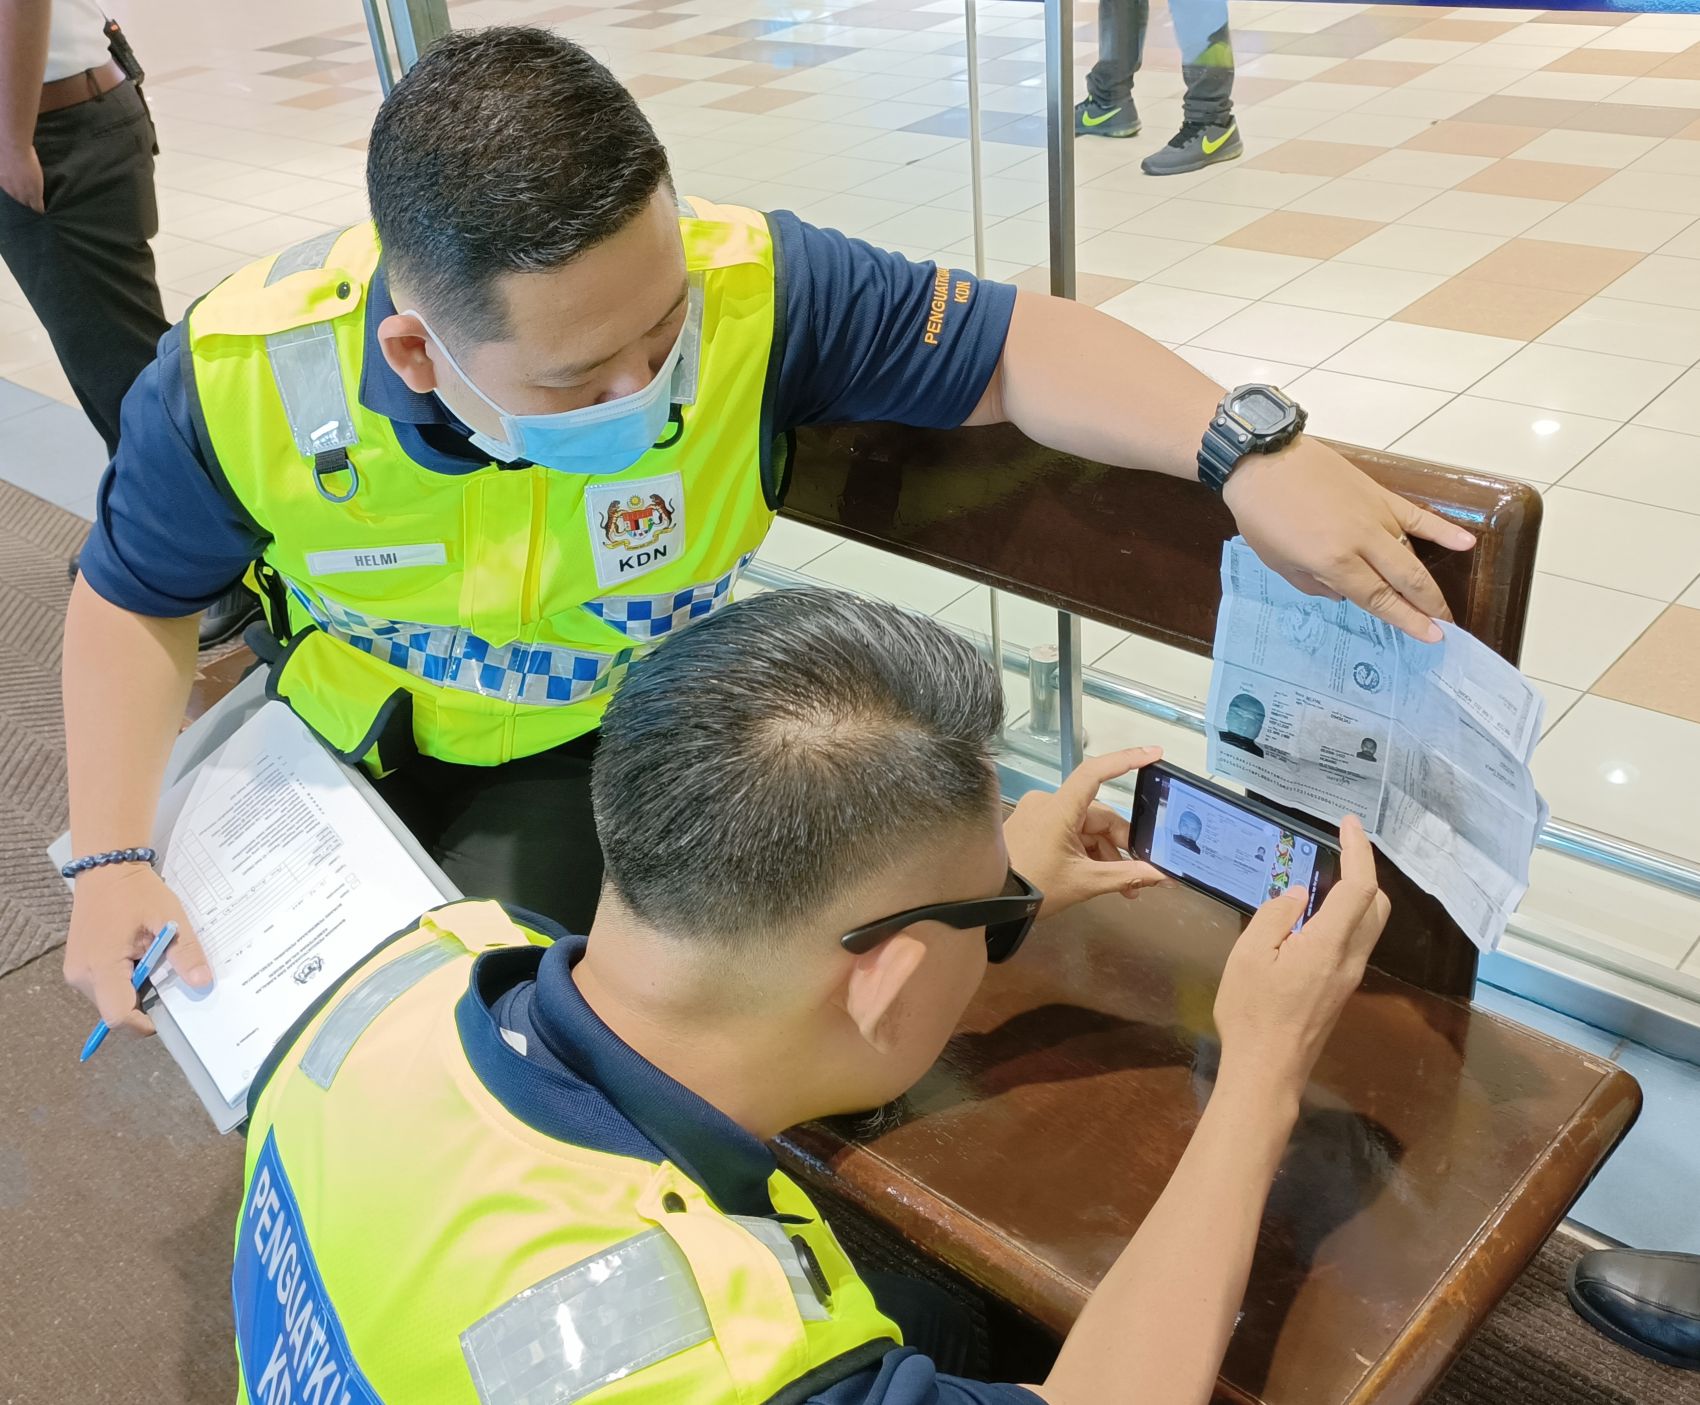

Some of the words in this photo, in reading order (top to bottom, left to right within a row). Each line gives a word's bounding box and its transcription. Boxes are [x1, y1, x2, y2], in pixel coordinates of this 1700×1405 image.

[954, 281, 971, 303] KDN
[354, 553, 398, 567] HELMI
[619, 545, 667, 572] KDN
